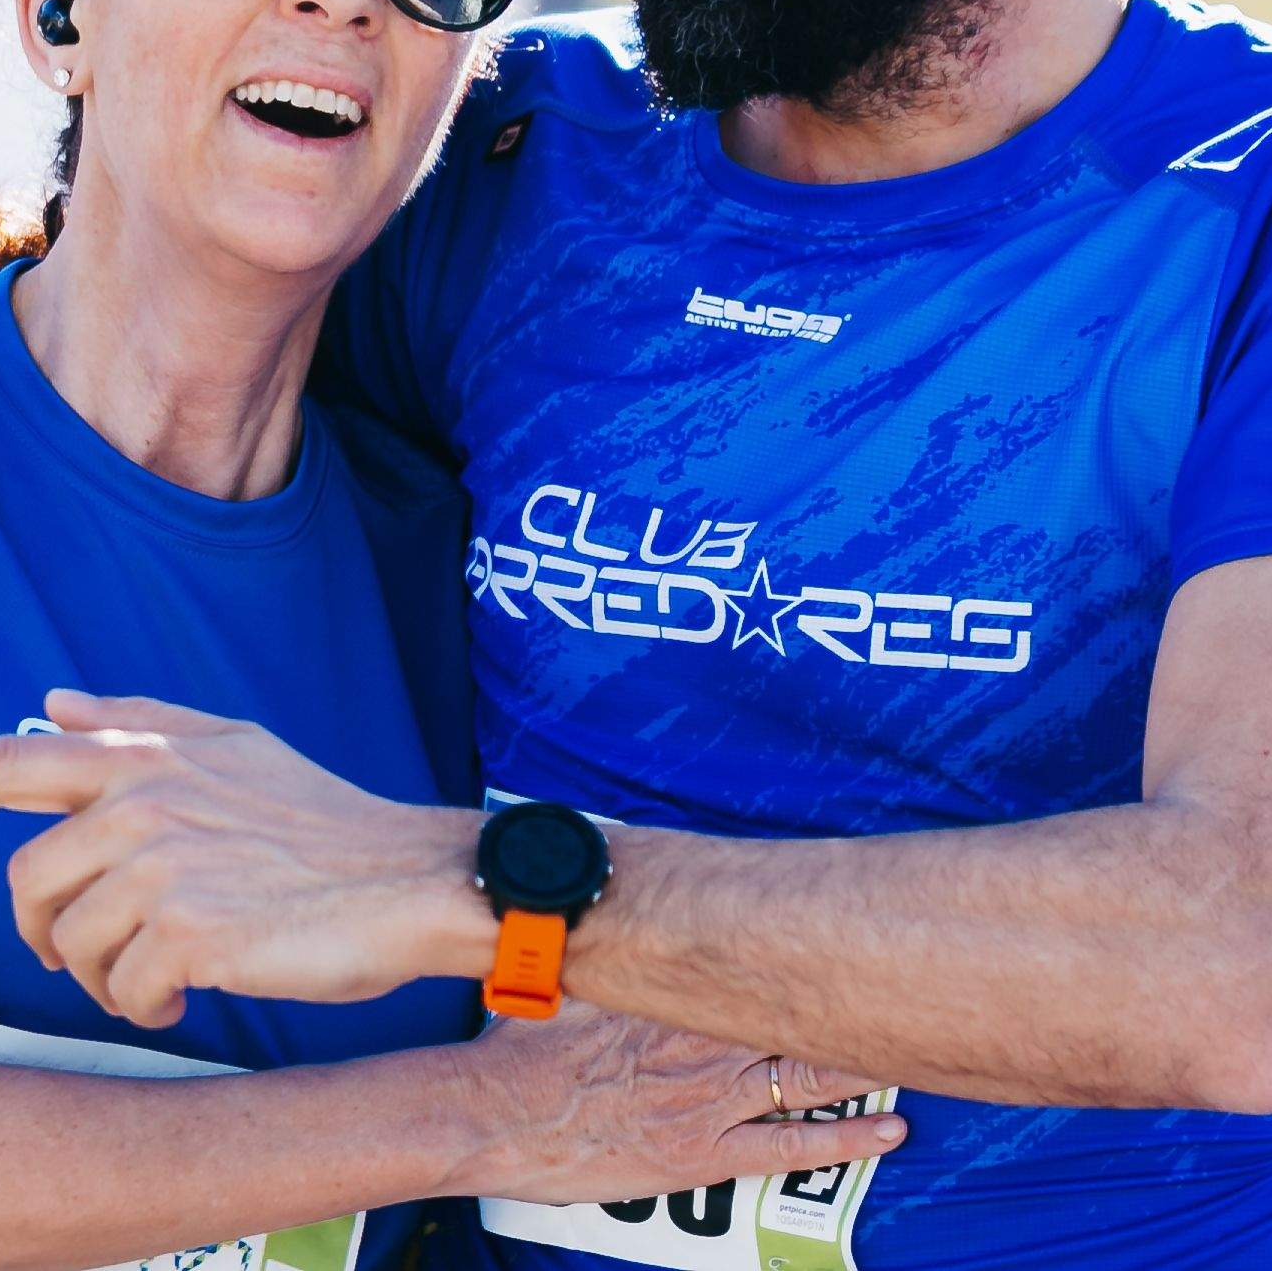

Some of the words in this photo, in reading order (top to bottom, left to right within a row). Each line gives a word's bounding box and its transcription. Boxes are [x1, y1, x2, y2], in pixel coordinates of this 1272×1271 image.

[684, 313, 738, 331] ACTIVE
[744, 323, 790, 338] WEAR
[522, 484, 758, 569] CLUB
